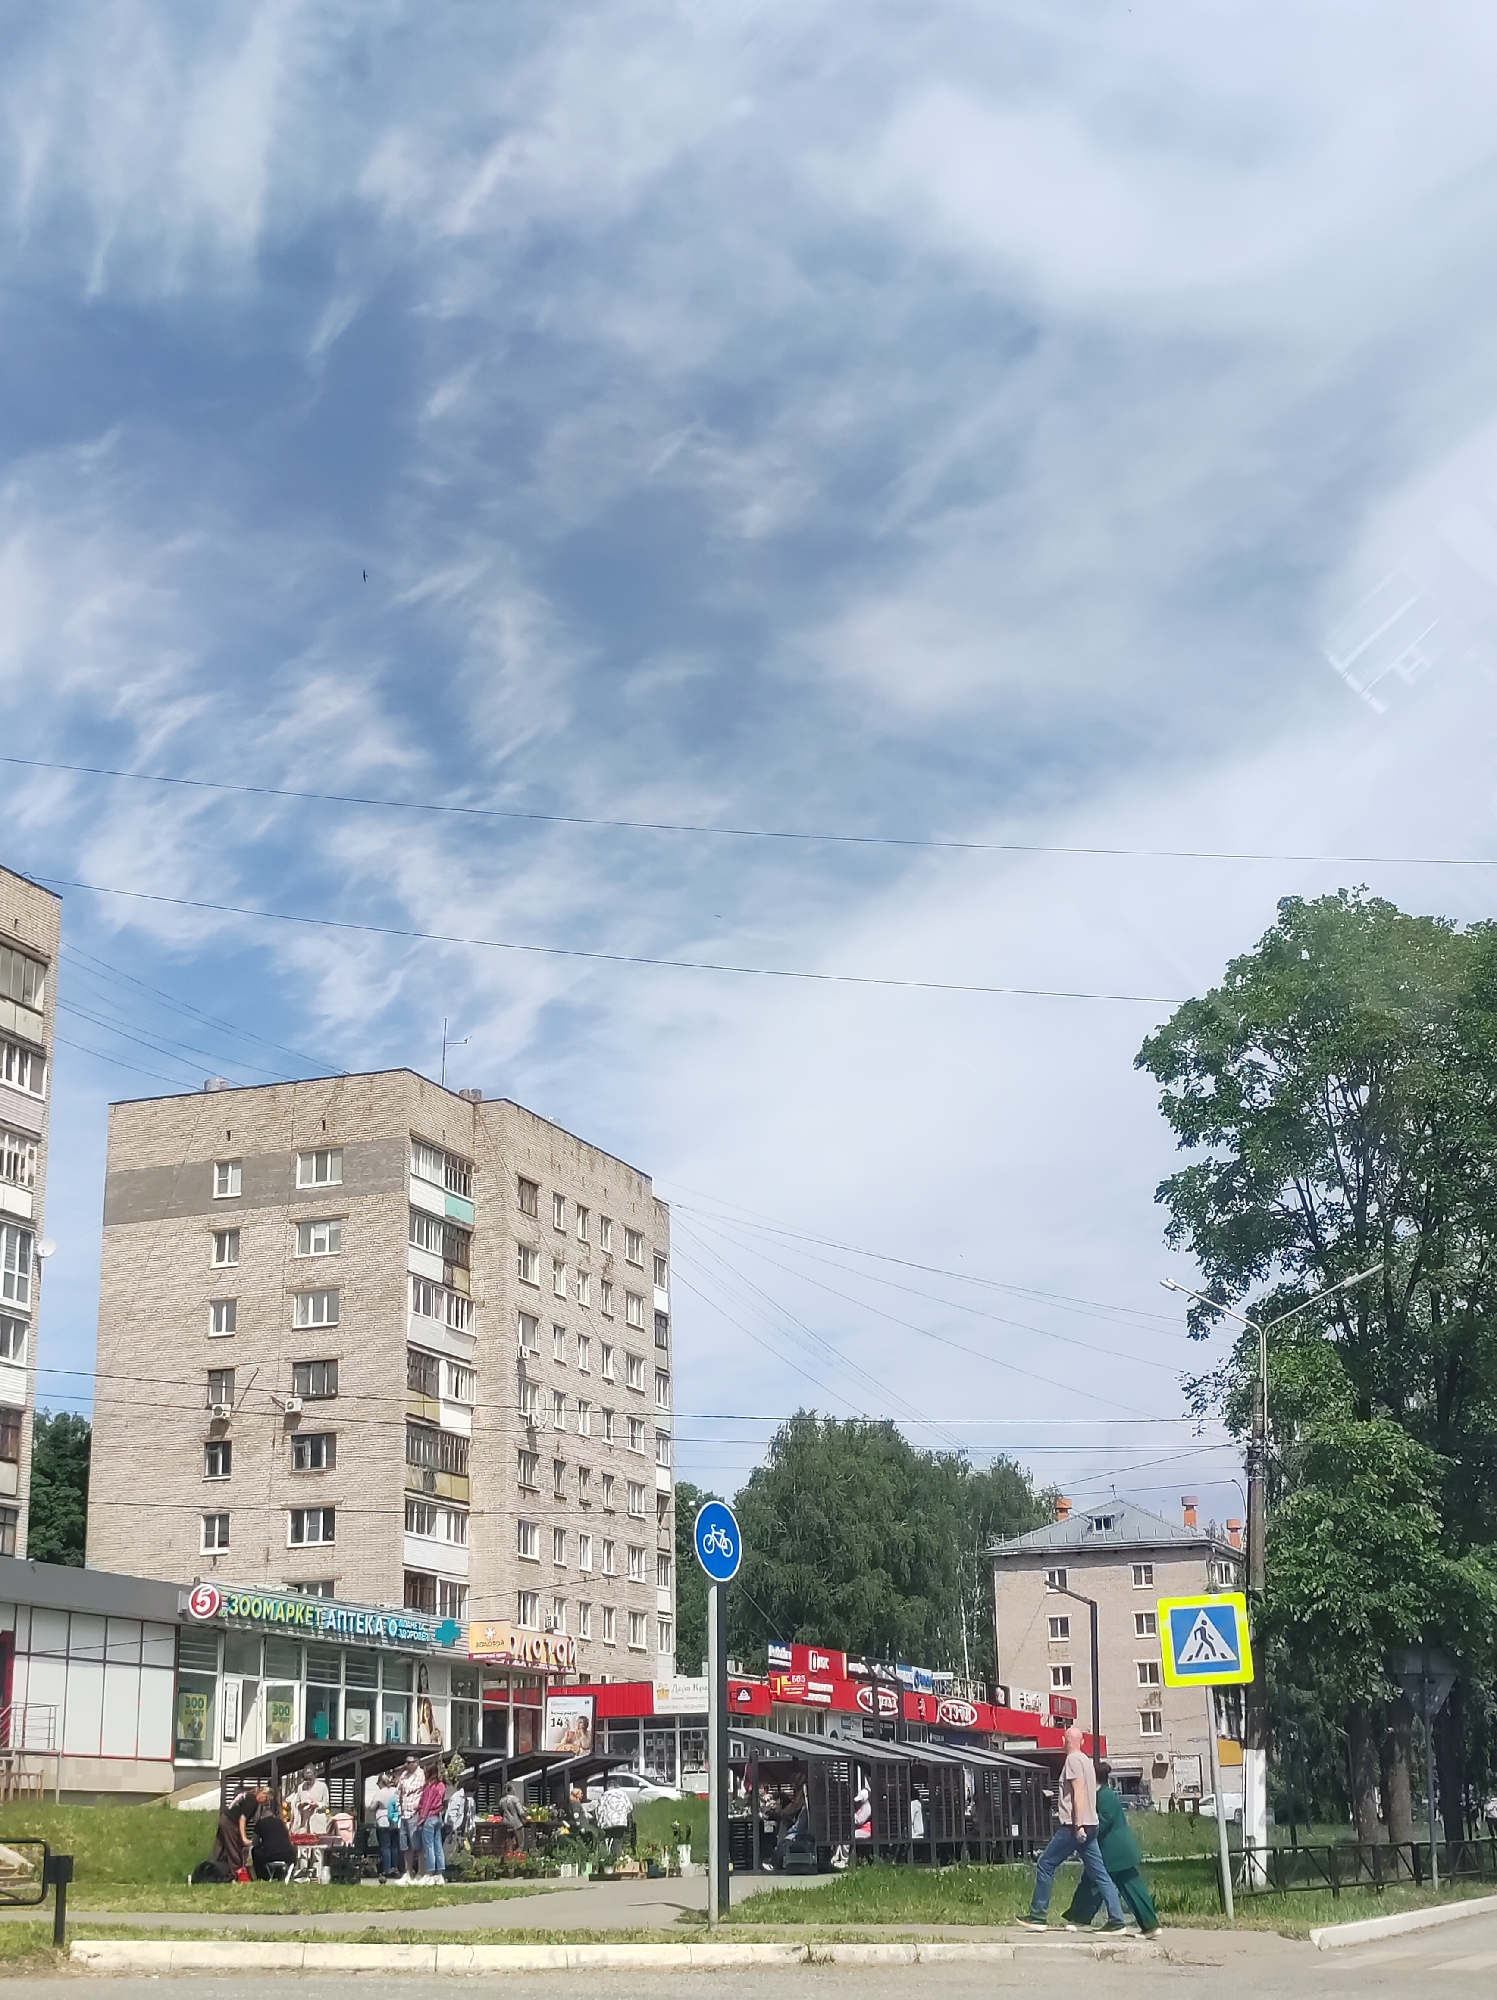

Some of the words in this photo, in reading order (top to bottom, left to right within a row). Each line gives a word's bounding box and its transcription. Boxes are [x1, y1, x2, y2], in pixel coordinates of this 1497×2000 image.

[194, 1585, 216, 1614] 5
[229, 1593, 323, 1626] ЗООМАРКЕТ
[325, 1607, 385, 1637] АПТЕКА
[510, 1630, 578, 1665] ОЛОТОЙ
